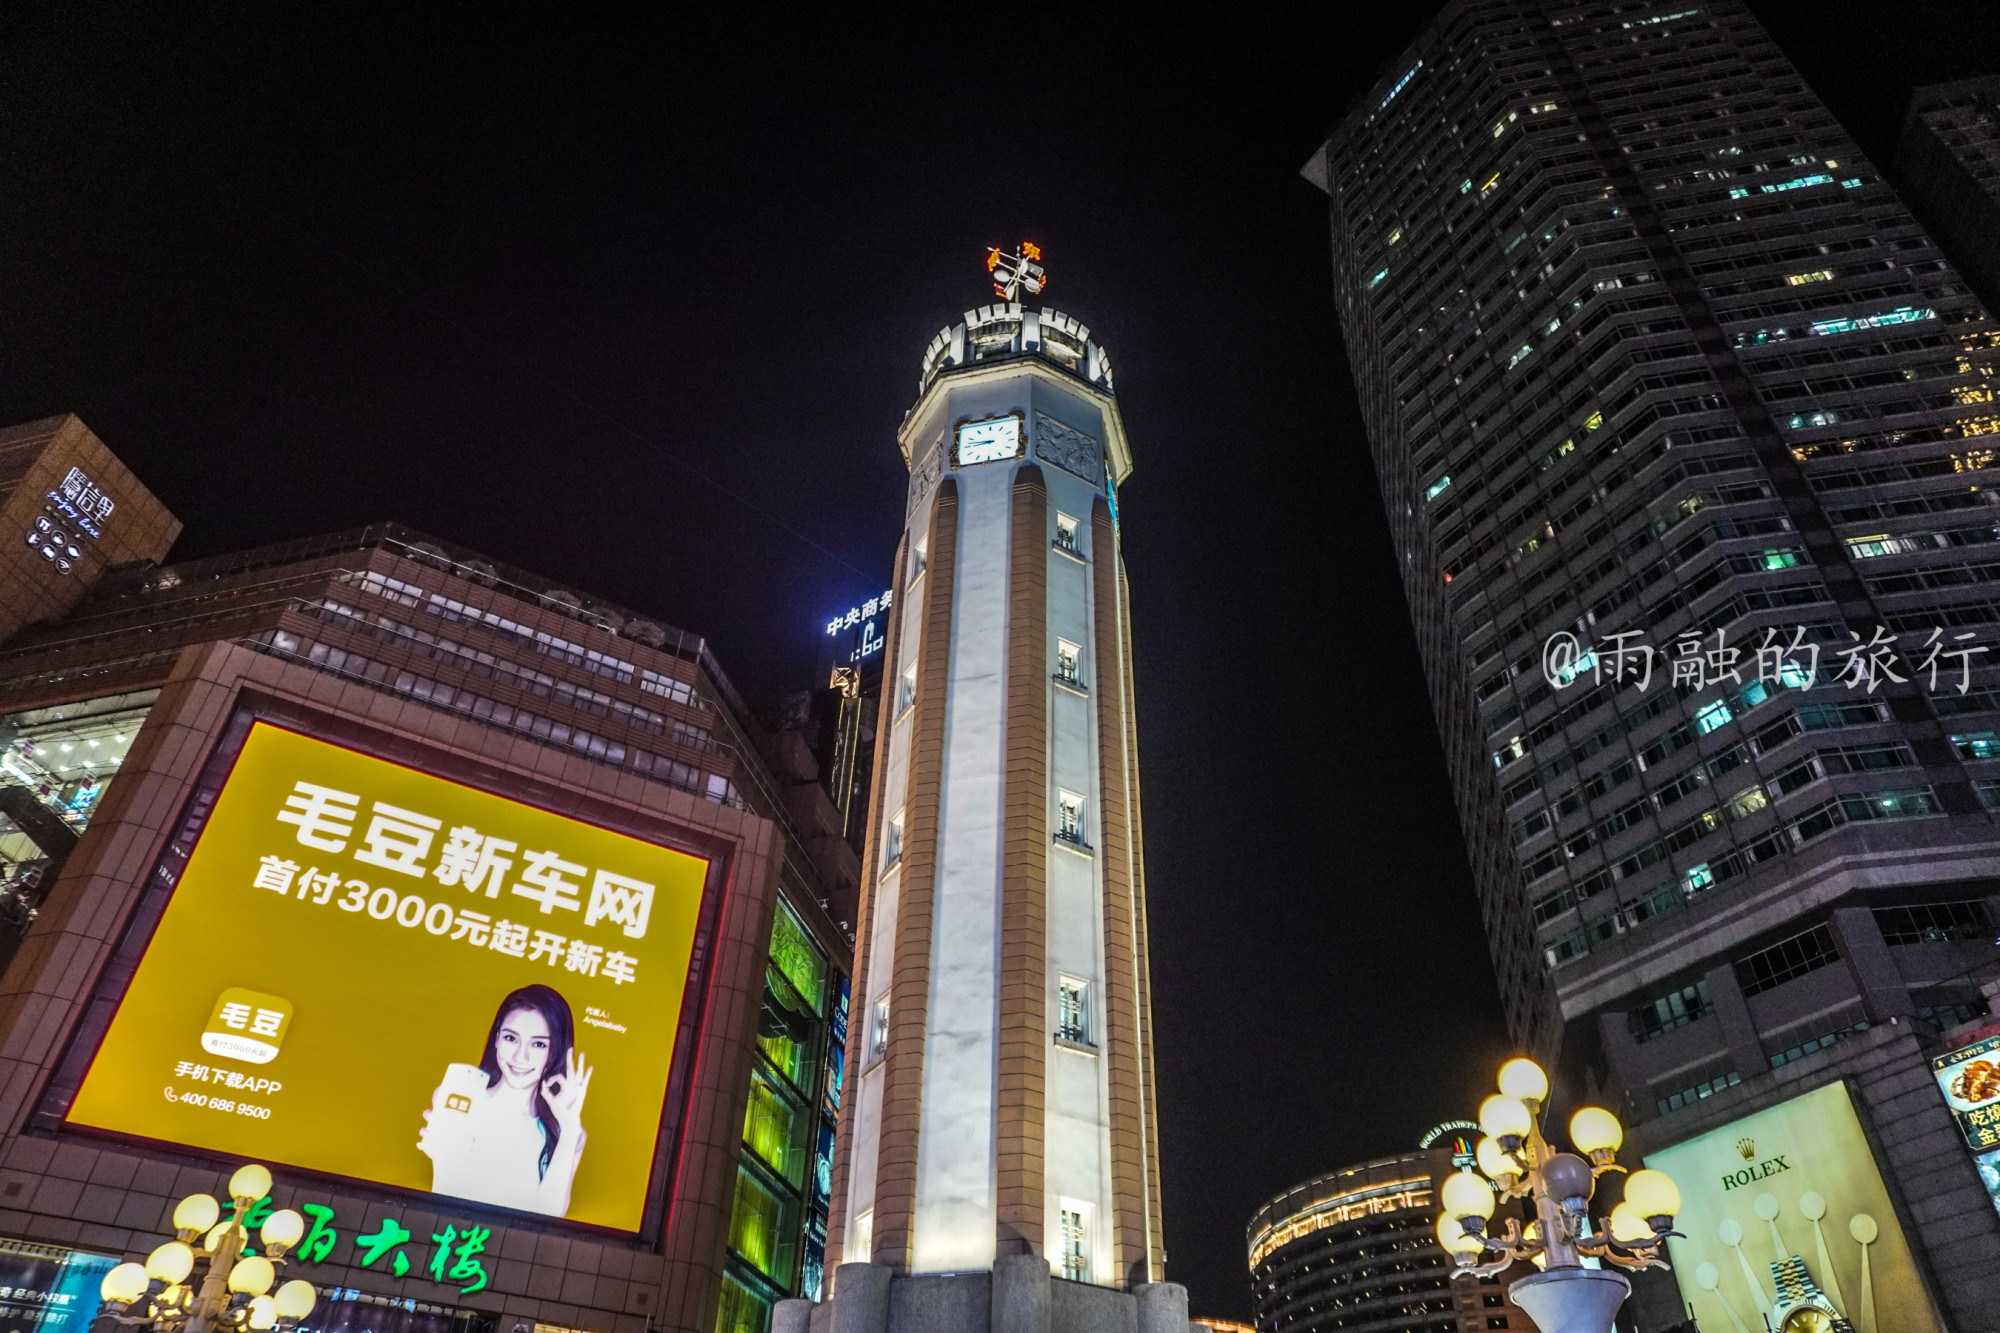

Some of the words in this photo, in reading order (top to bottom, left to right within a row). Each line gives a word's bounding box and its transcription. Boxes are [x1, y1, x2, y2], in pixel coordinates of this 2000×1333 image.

[46, 491, 79, 519] enjoy
[78, 517, 101, 539] here
[276, 780, 656, 940] 毛豆新车网
[252, 854, 639, 985] 首付3000元起开新车
[219, 1001, 285, 1038] 毛豆
[174, 1060, 282, 1096] 手机下载APP
[180, 1091, 208, 1107] 400
[208, 1097, 236, 1113] 686
[236, 1104, 271, 1120] 9500
[1420, 1126, 1443, 1150] WORLD
[1721, 1155, 1791, 1191] ROLEX
